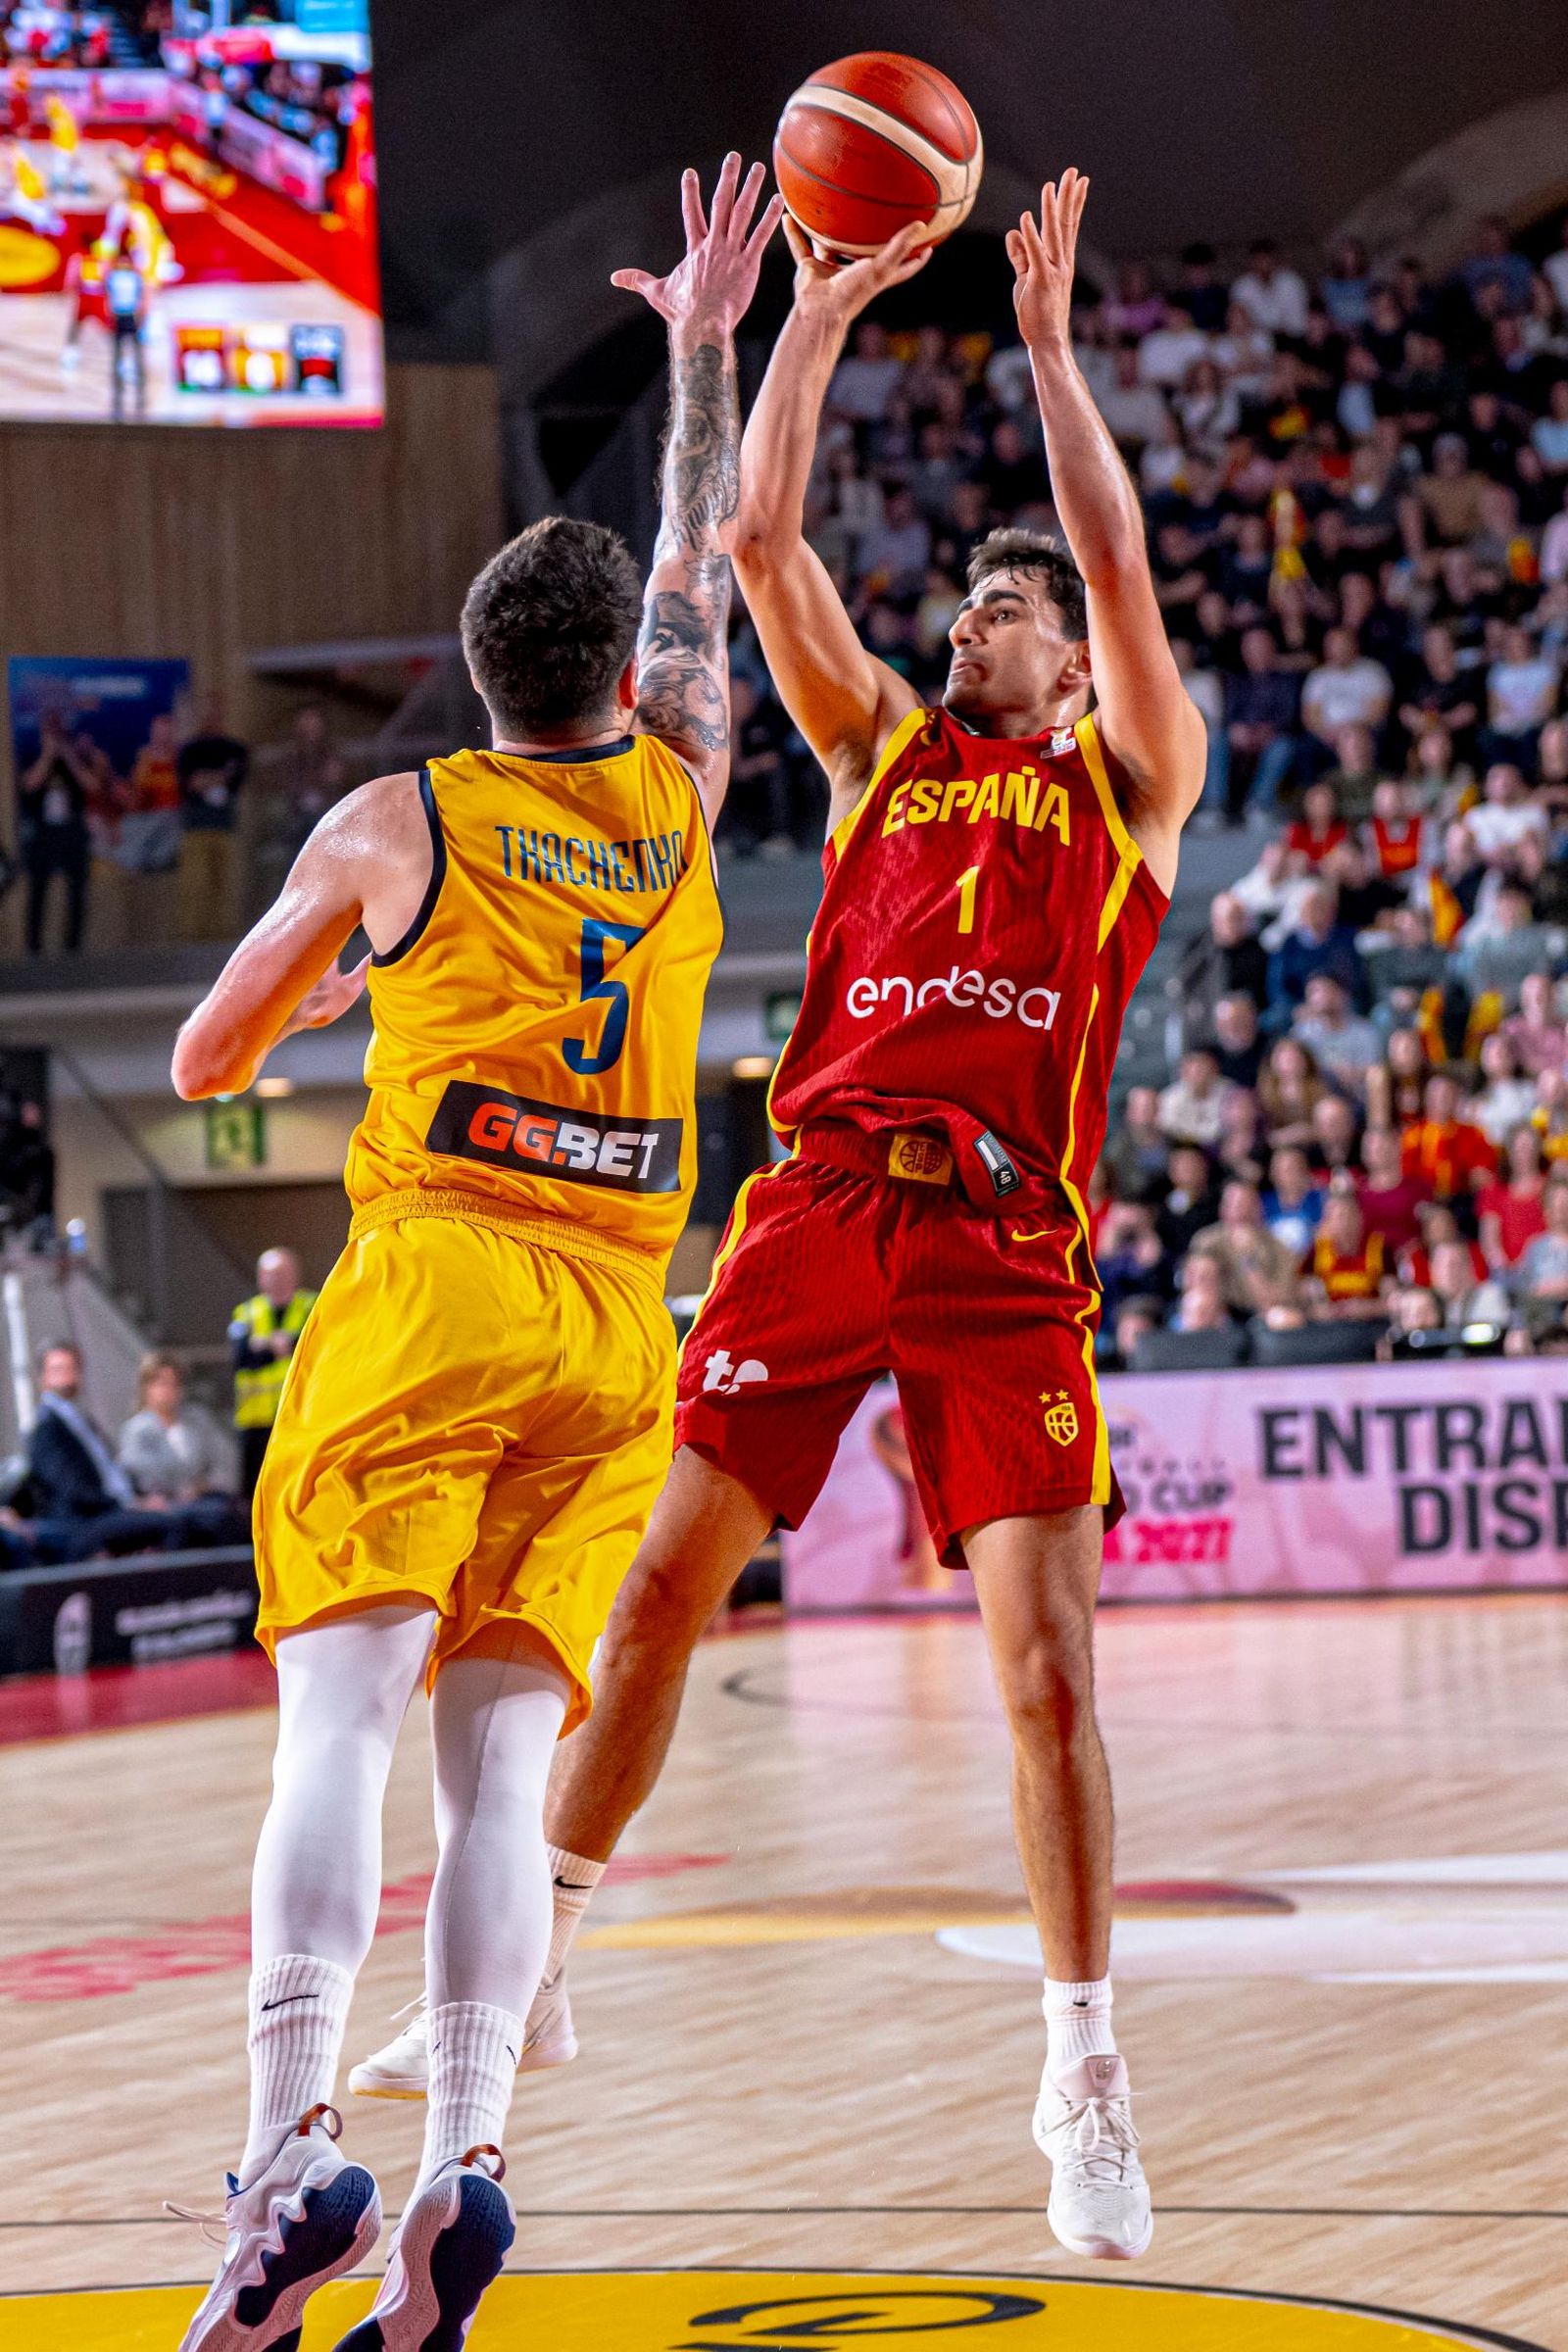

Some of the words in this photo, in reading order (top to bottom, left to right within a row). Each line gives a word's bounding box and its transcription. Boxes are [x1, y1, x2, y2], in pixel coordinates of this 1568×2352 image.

[881, 765, 1071, 847] ESPAÑA
[956, 865, 980, 934] 1
[562, 916, 647, 1075] 5
[846, 965, 1061, 1030] endesa
[467, 1102, 660, 1179] GG.BET
[1260, 1399, 1568, 1476] ENTRA
